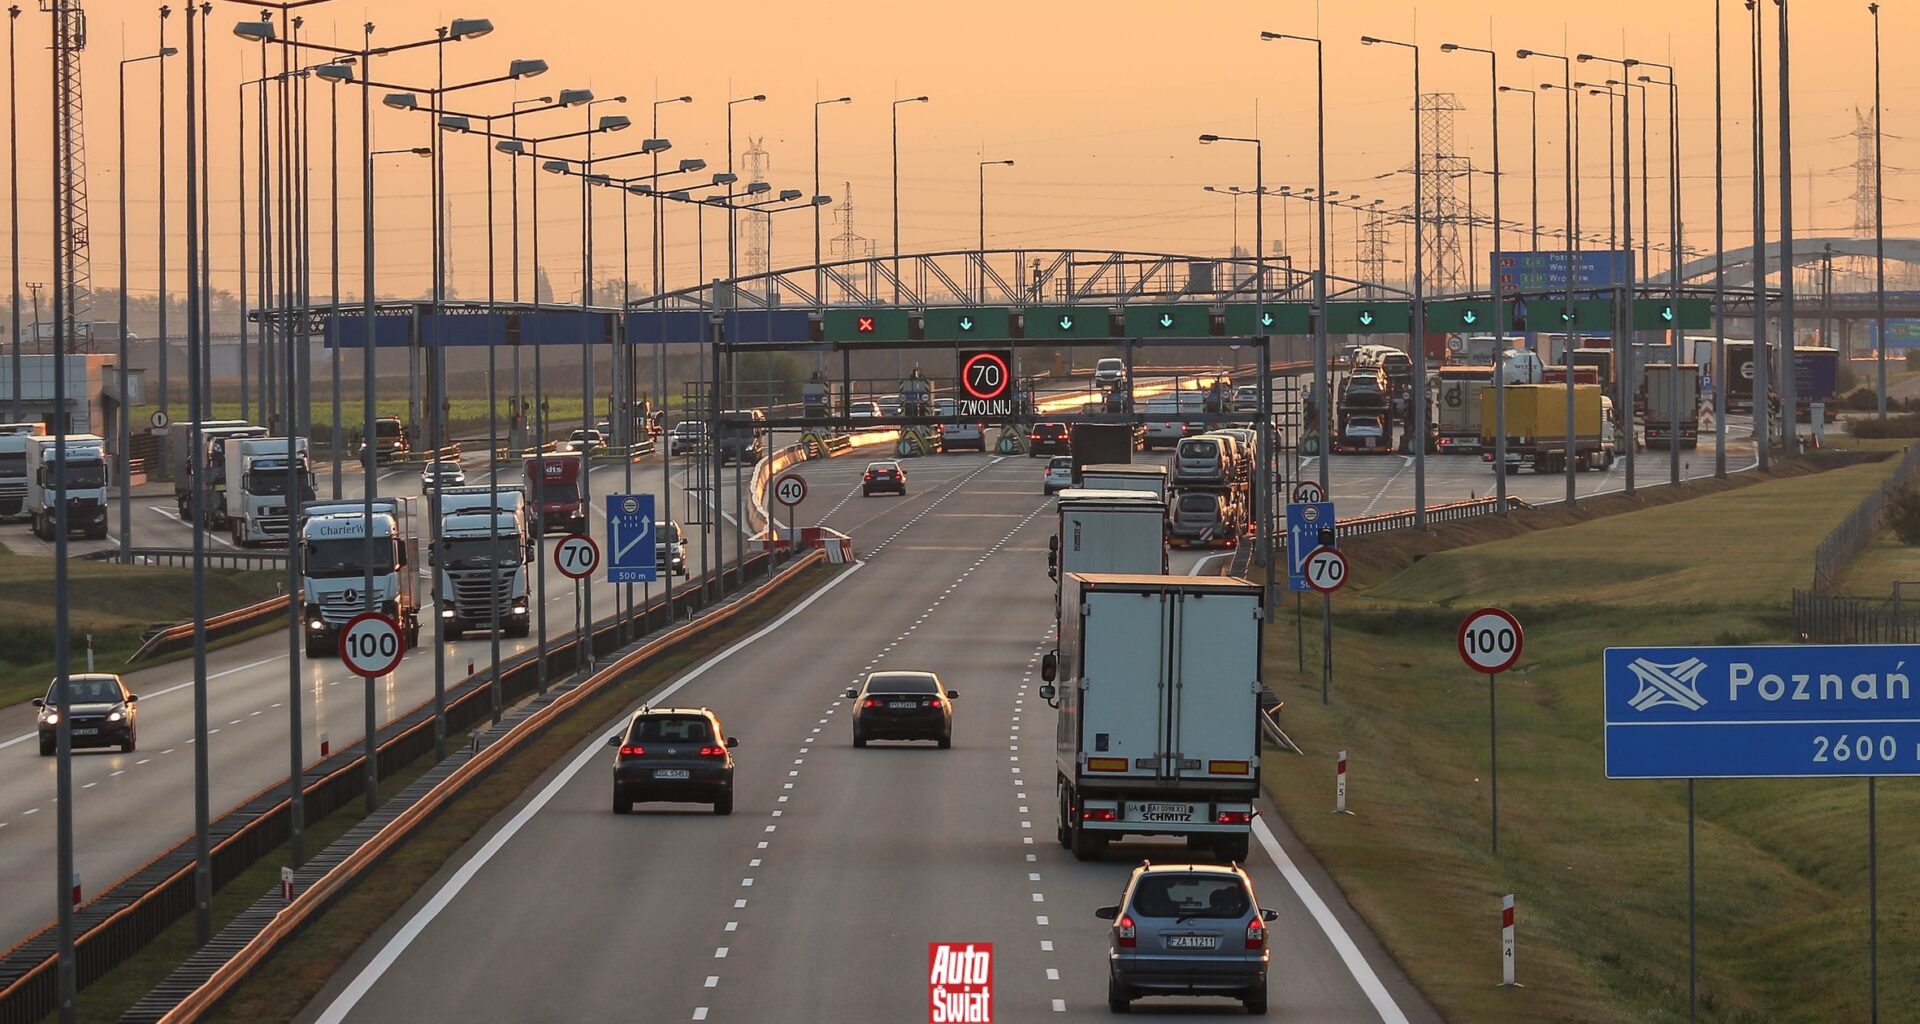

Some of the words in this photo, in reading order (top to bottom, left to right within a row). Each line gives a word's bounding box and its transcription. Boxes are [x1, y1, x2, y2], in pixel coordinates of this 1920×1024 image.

[973, 365, 999, 386] 70
[960, 400, 1011, 415] ZWOLNIJ
[780, 483, 801, 498] 40
[1300, 489, 1320, 503] 40
[564, 546, 593, 567] 70
[619, 572, 636, 580] 500
[1314, 560, 1343, 580] 70
[348, 633, 397, 658] 100
[1466, 628, 1515, 654] 100
[1729, 661, 1910, 701] Poznań
[1812, 734, 1897, 762] 2600
[1142, 812, 1192, 822] SCHMITZ
[1504, 947, 1512, 957] 4
